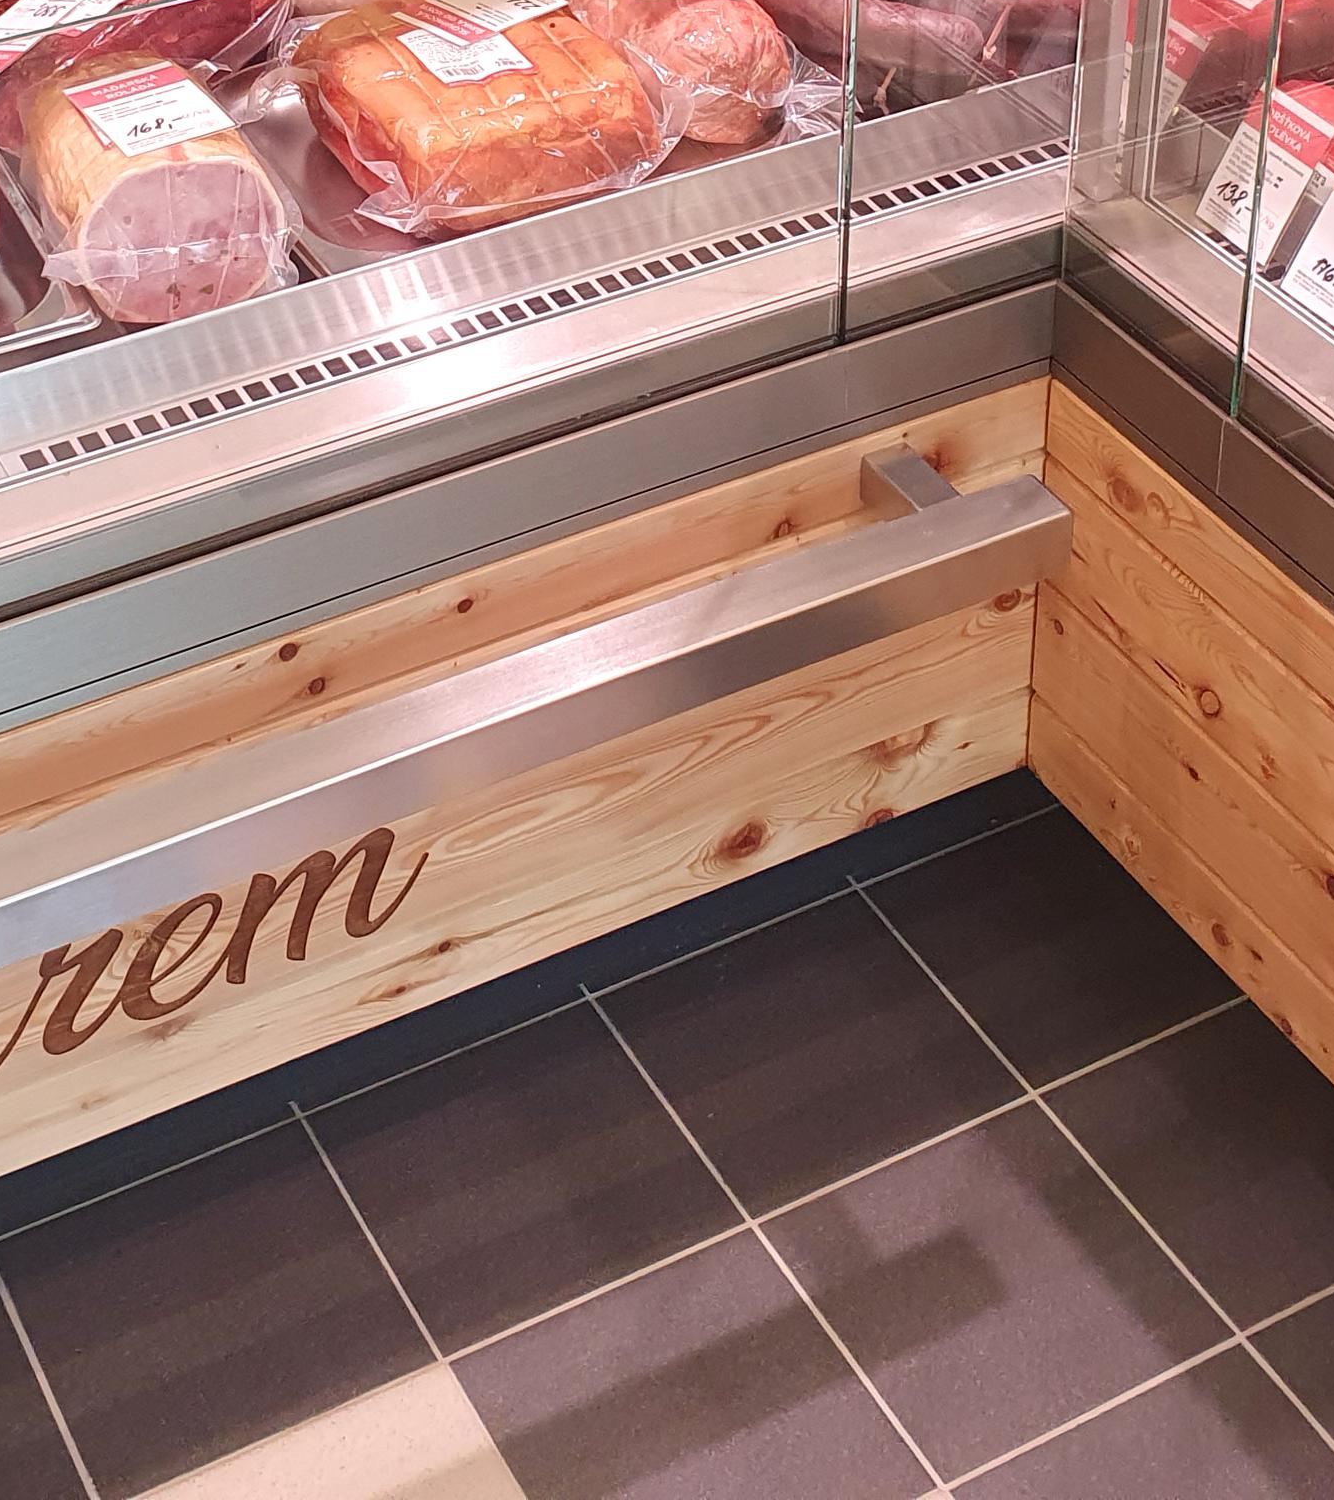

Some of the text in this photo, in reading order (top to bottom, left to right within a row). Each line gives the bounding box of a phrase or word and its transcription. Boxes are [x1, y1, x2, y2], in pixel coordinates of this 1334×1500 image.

[127, 116, 184, 137] 168,-
[1266, 122, 1304, 152] OLÉVKA
[1217, 180, 1252, 214] 138,-
